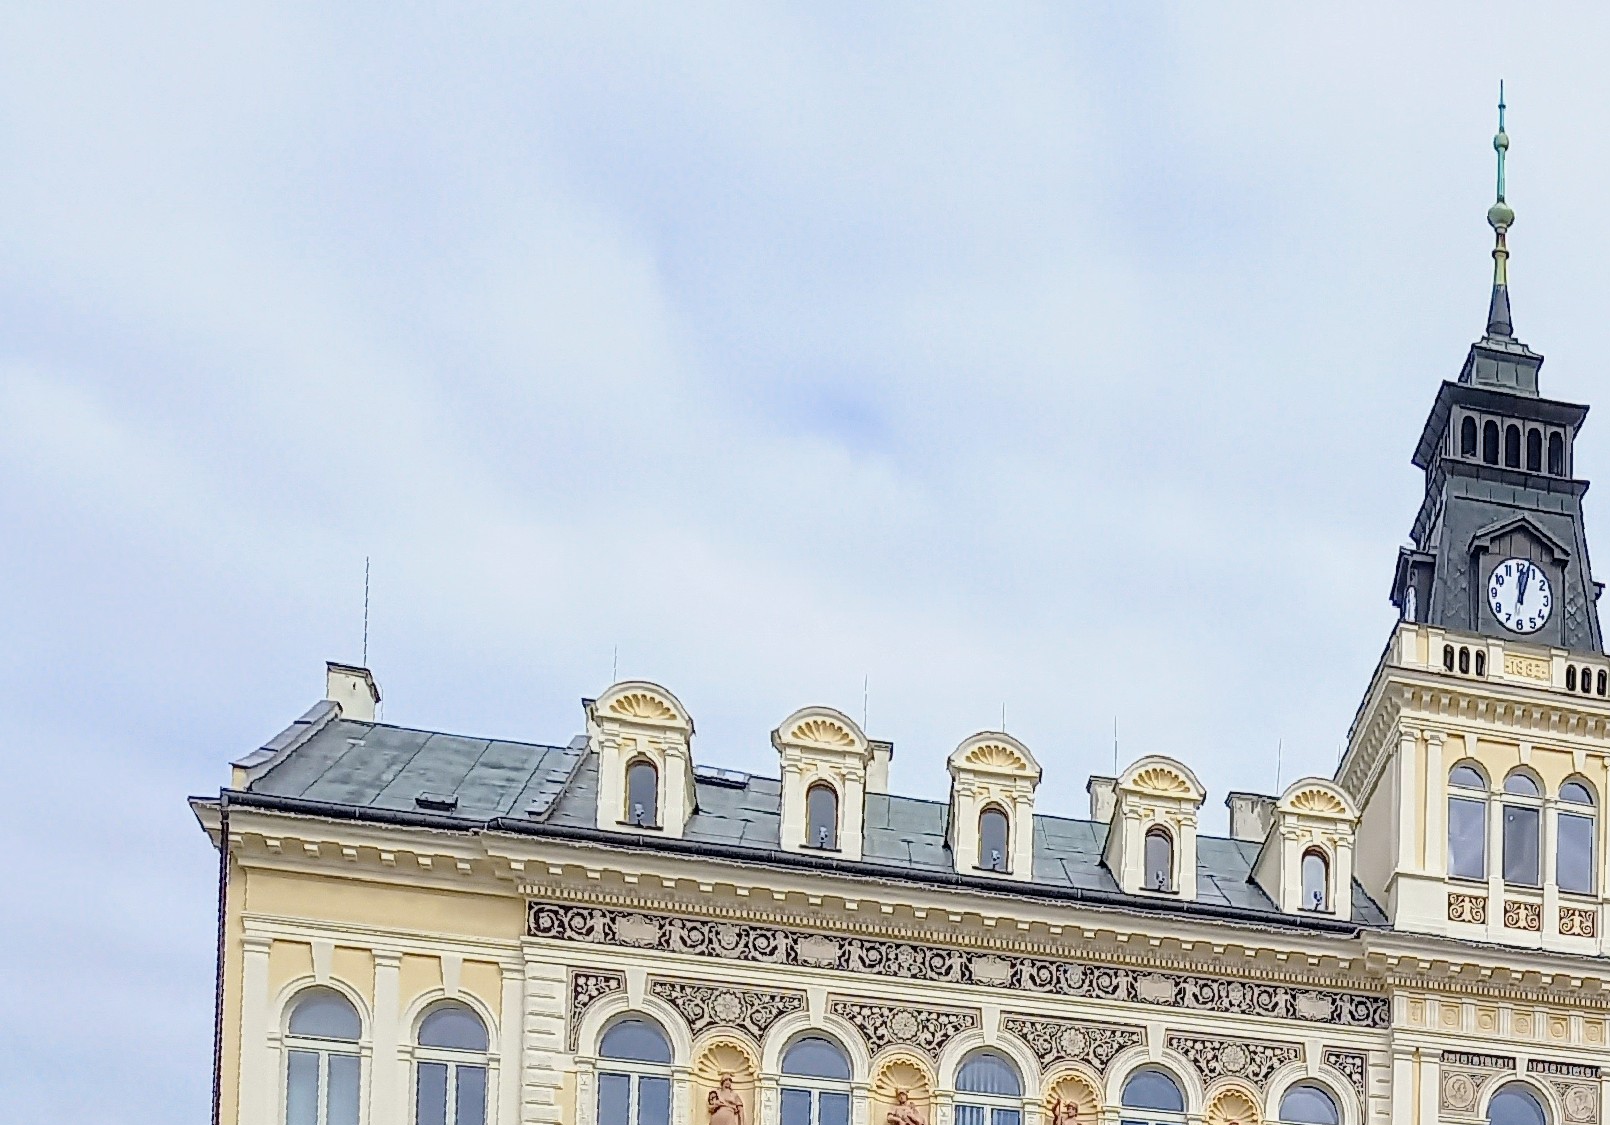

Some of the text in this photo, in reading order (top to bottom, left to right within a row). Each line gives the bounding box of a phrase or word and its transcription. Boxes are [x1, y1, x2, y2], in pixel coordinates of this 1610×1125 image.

[1505, 565, 1511, 577] 11
[1532, 569, 1536, 580] 1
[1495, 573, 1504, 586] 10
[1539, 580, 1545, 591] 2
[1491, 587, 1497, 598] 9
[1543, 595, 1548, 607] 3
[1495, 602, 1501, 613] 8
[1505, 613, 1512, 623] 7
[1538, 609, 1544, 620] 4
[1516, 619, 1523, 630] 6
[1529, 617, 1536, 629] 5
